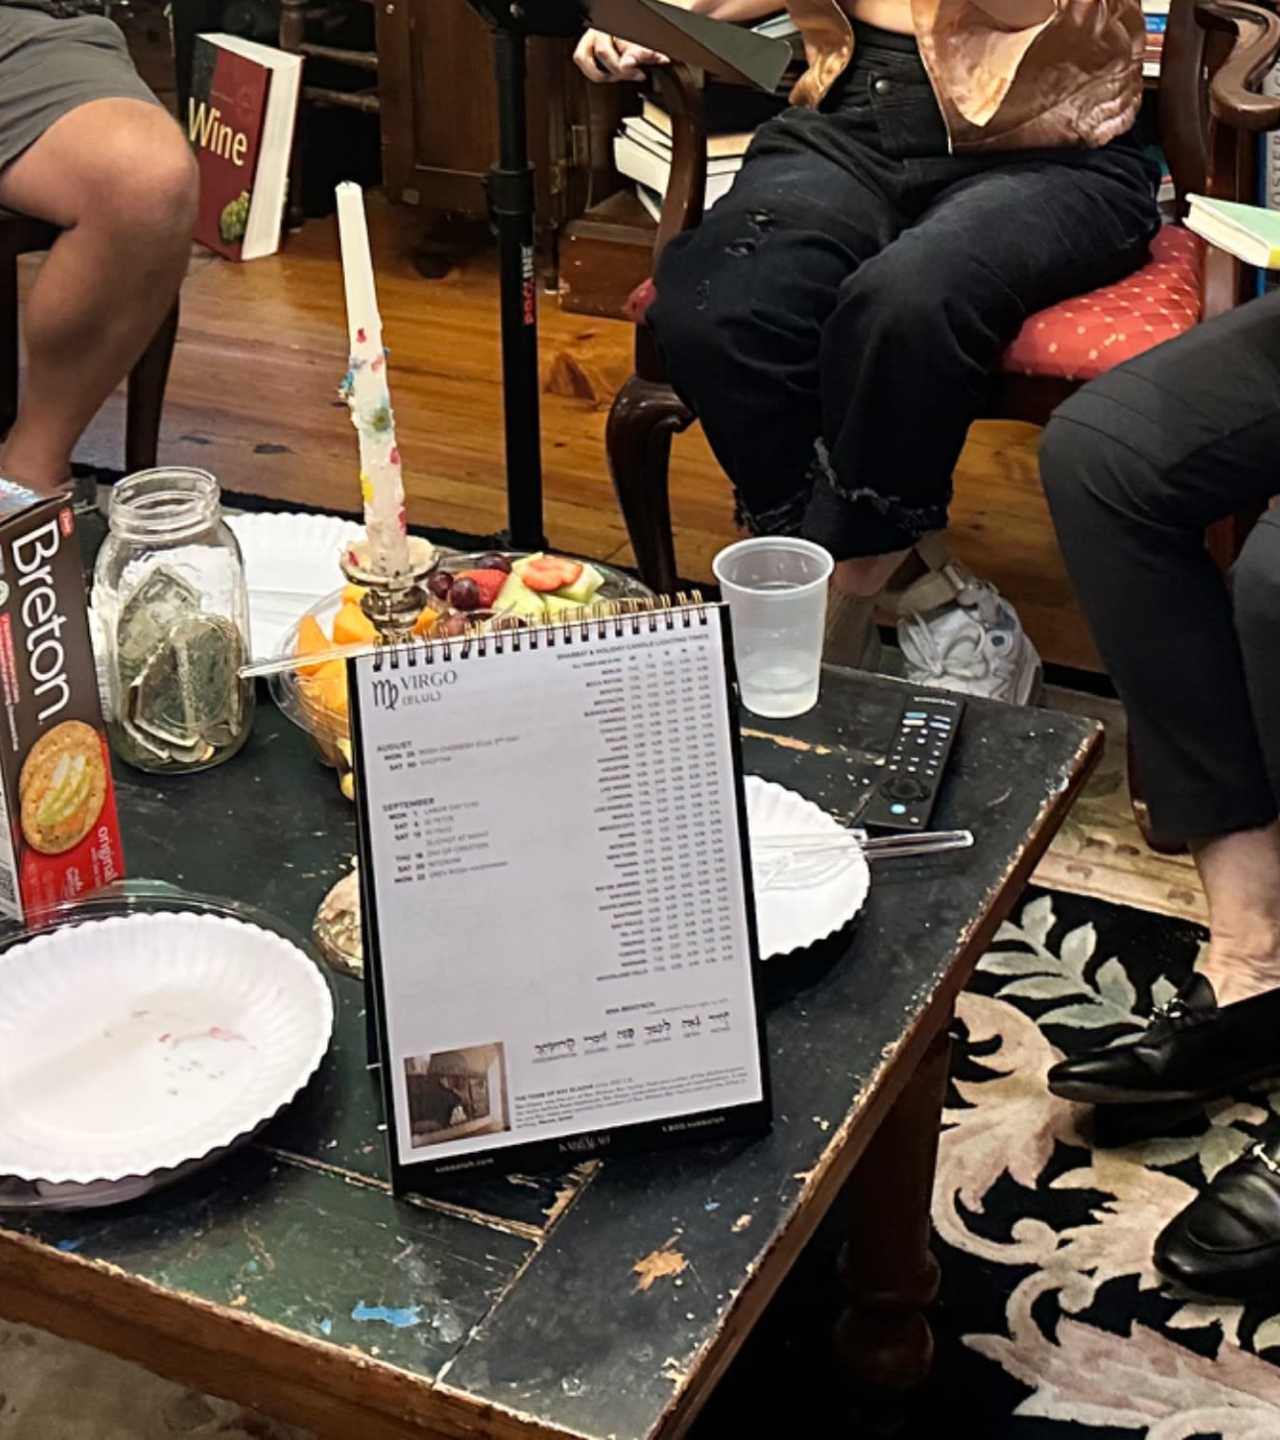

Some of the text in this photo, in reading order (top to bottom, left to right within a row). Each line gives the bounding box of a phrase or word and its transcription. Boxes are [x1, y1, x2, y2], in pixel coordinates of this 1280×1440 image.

[186, 94, 249, 167] Wine
[11, 519, 71, 722] Breton
[400, 669, 458, 691] VIRGO
[96, 825, 120, 883] original
